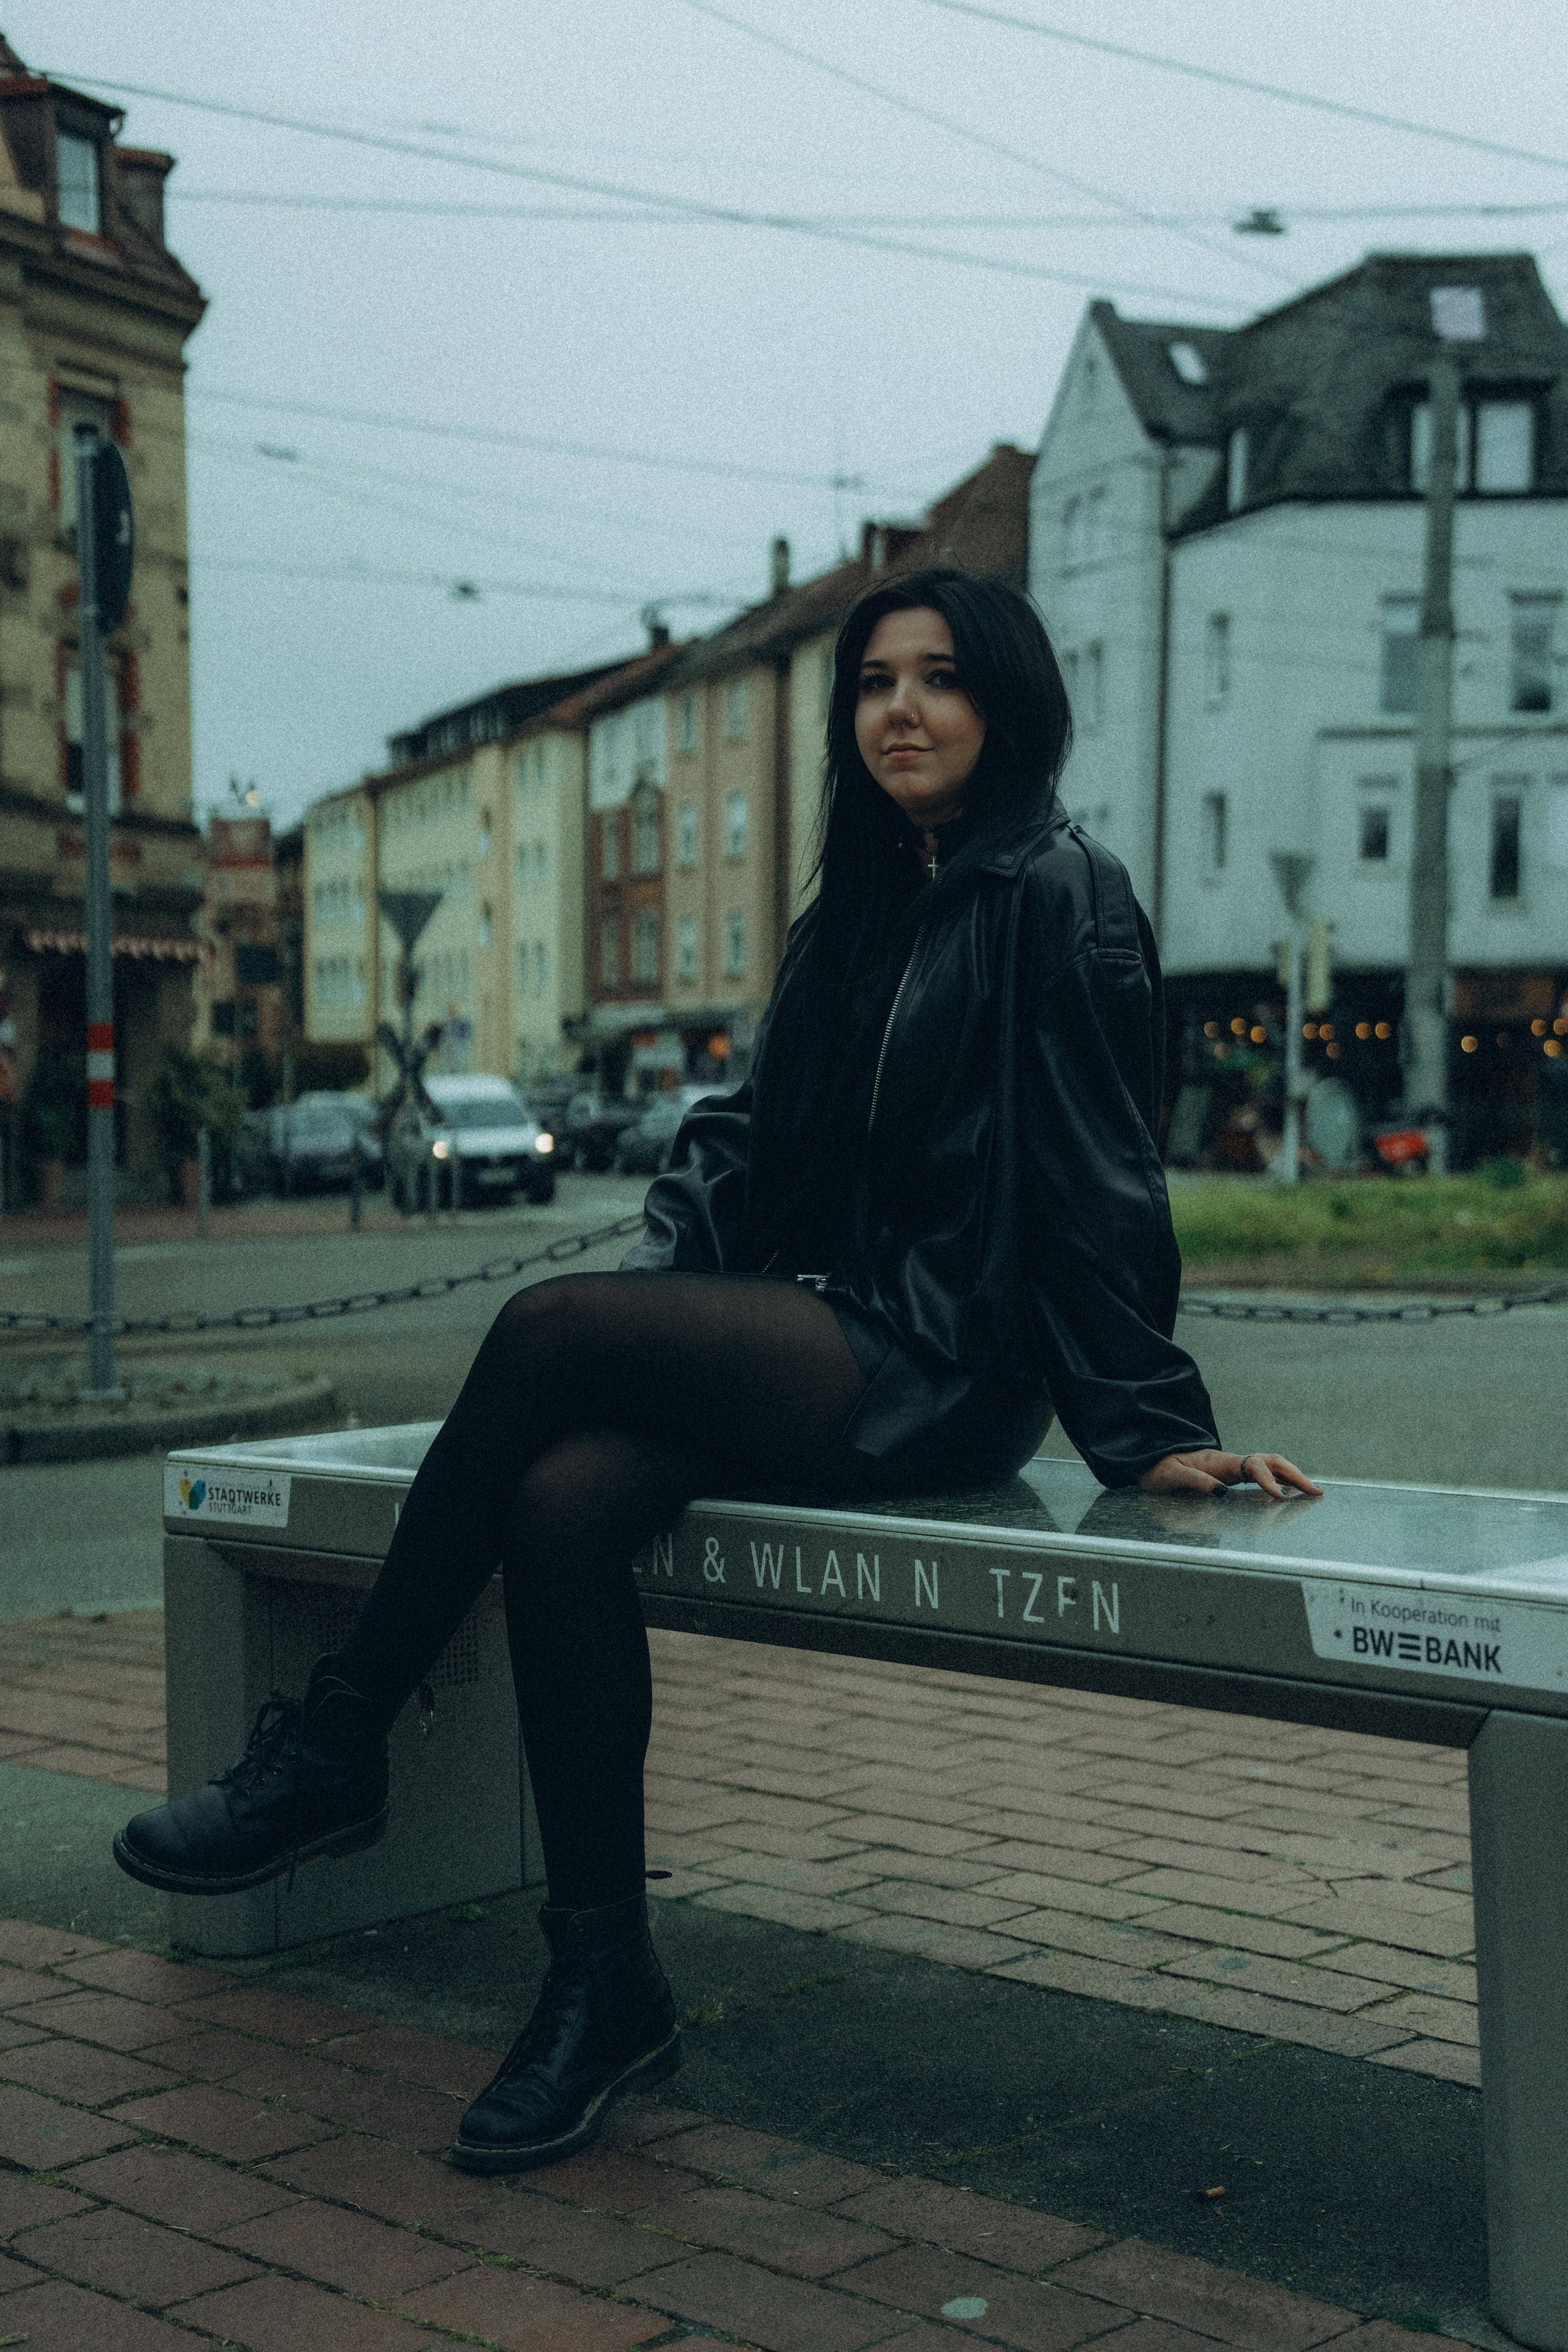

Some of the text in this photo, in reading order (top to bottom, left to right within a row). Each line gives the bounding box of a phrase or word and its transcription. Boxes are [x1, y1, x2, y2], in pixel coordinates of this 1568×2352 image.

[208, 1487, 281, 1506] STADTWERKE
[209, 1501, 252, 1515] STUTTGART
[703, 1536, 726, 1583] &
[750, 1541, 880, 1602] WLAN
[1351, 1599, 1501, 1634] In Kooperation mit
